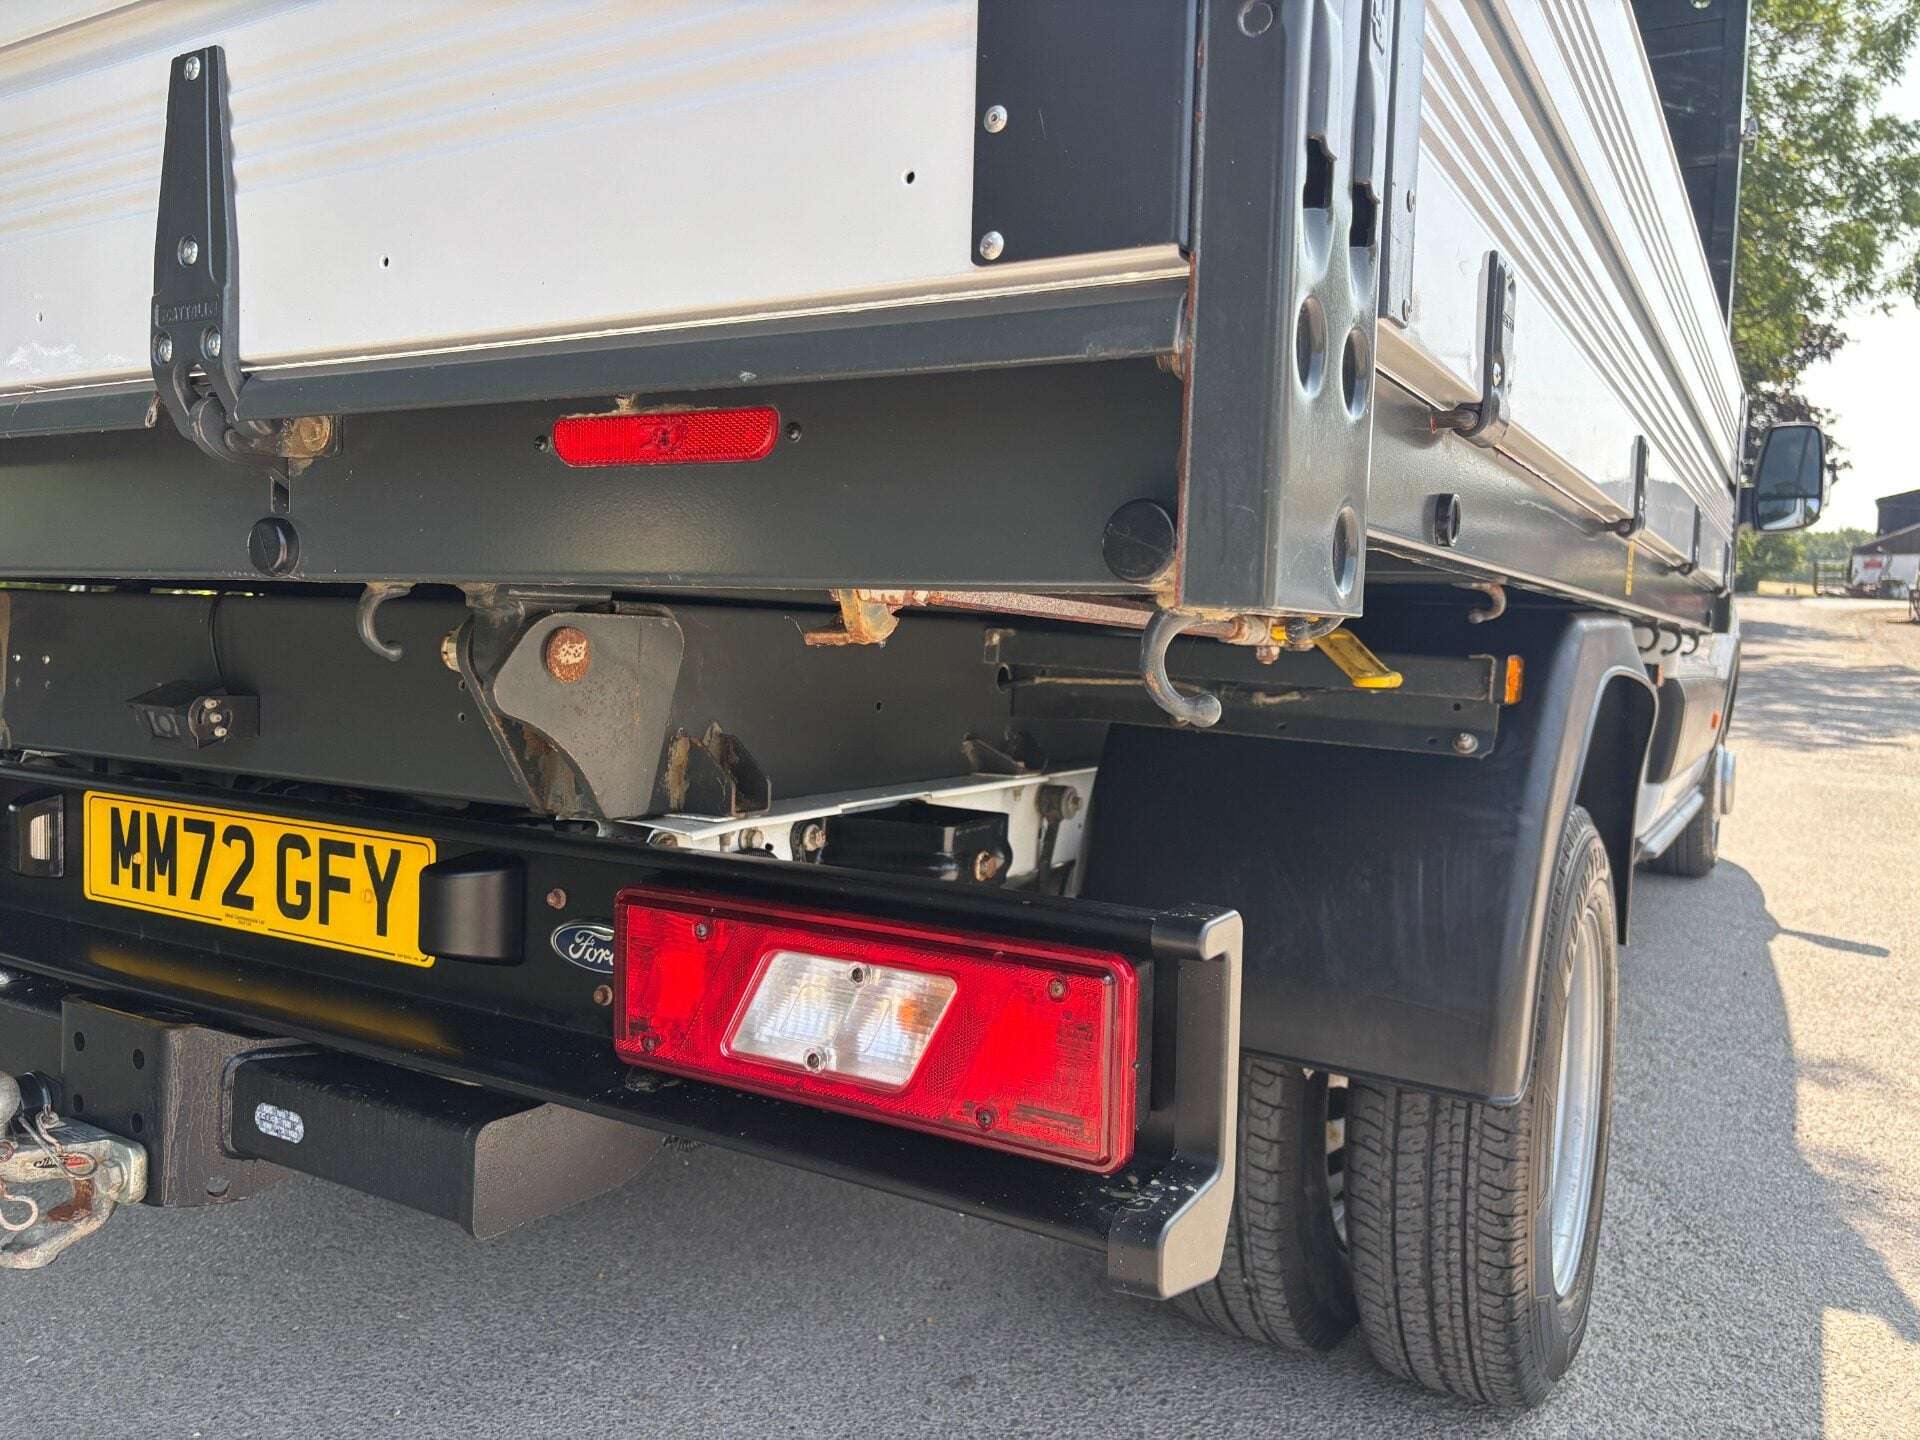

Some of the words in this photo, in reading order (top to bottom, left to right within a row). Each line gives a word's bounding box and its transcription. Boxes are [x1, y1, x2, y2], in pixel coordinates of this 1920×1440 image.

[110, 806, 255, 912] MM72
[276, 832, 401, 937] GFY
[568, 930, 614, 966] For
